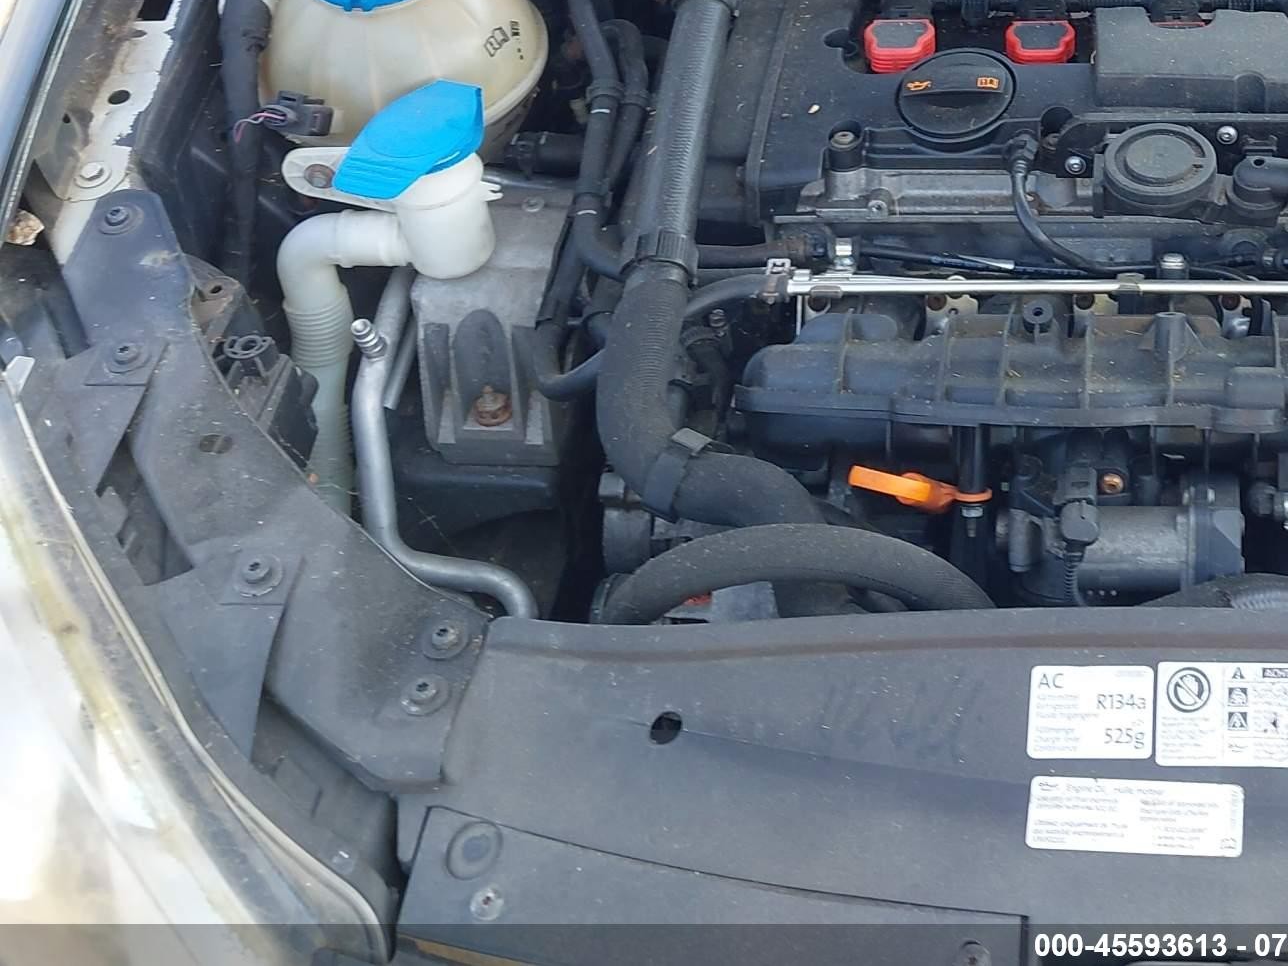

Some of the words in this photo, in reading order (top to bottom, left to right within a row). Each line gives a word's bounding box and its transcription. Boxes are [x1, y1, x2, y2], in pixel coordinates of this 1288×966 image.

[1038, 673, 1065, 689] AC
[1097, 693, 1147, 710] R134a
[1104, 728, 1146, 749] 525g
